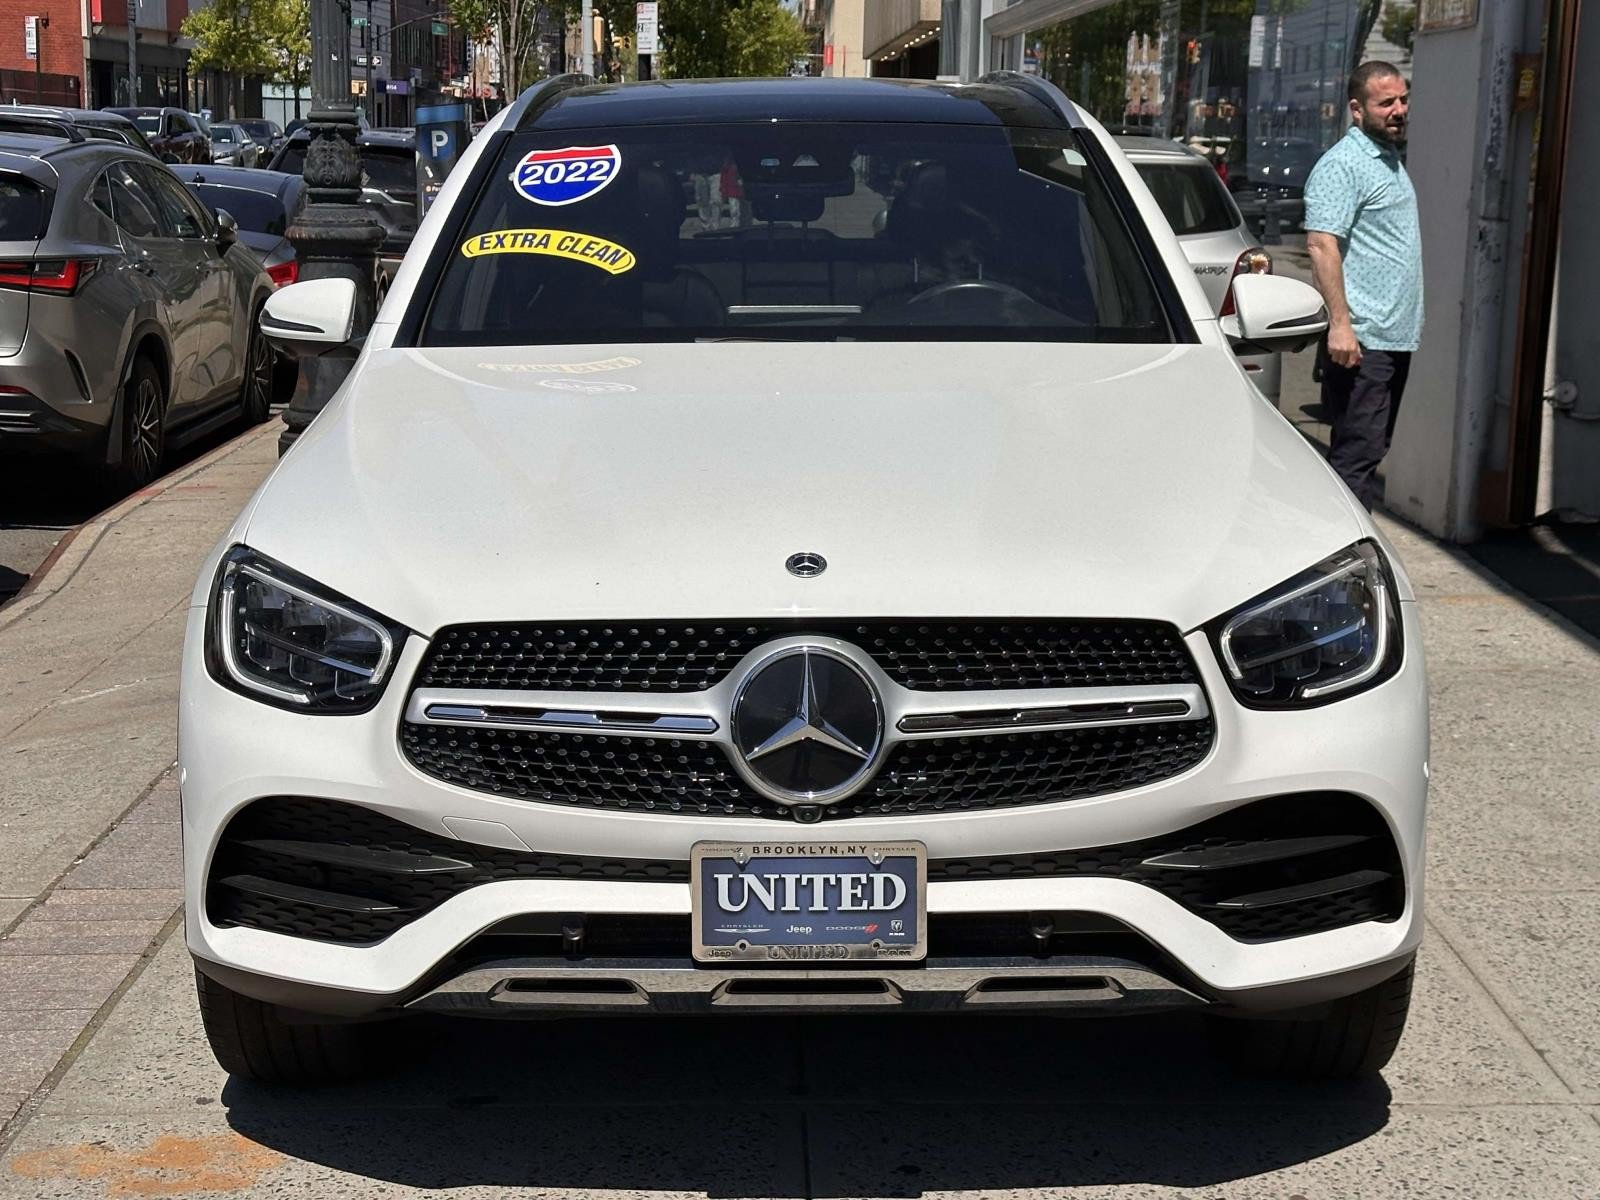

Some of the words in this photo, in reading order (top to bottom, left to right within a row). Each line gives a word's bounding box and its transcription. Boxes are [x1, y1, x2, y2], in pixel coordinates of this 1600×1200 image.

[431, 130, 449, 157] P
[520, 159, 611, 187] 2022
[479, 232, 552, 251] EXTRA
[556, 235, 626, 266] CLEAN
[713, 873, 907, 912] UNITED
[786, 924, 813, 935] Jeep
[708, 949, 733, 958] Jeep
[767, 945, 848, 959] UNITED
